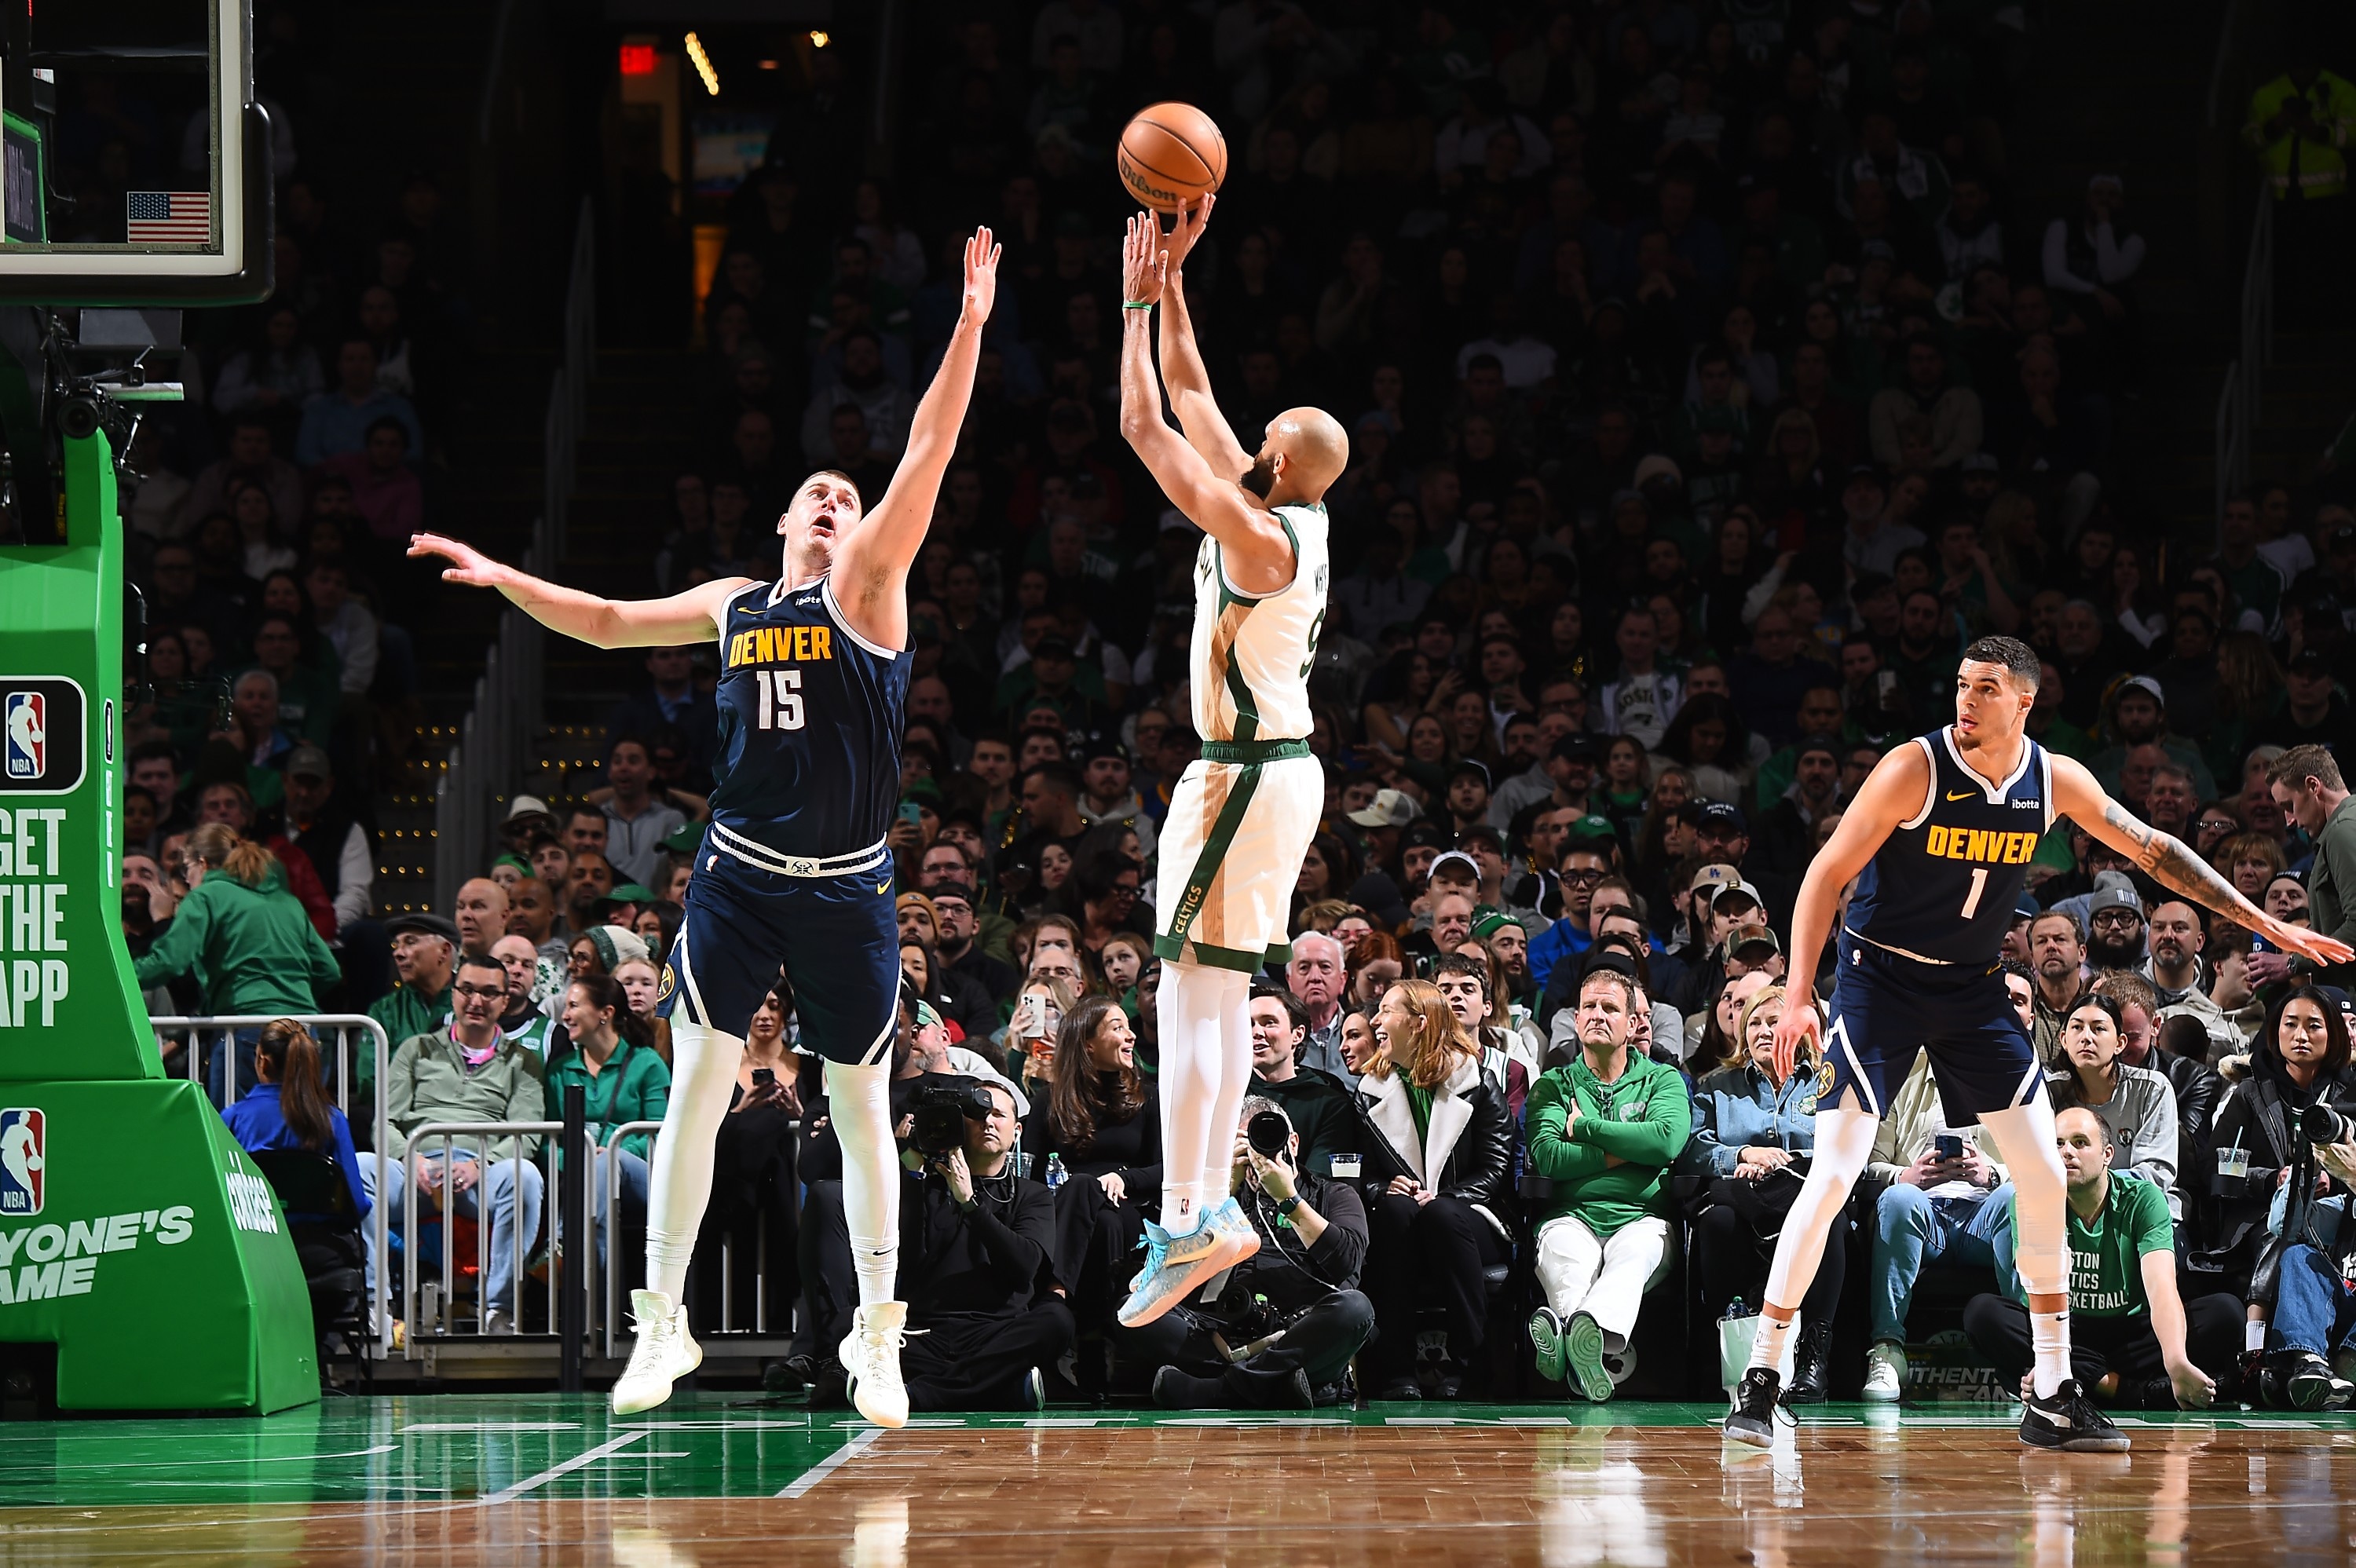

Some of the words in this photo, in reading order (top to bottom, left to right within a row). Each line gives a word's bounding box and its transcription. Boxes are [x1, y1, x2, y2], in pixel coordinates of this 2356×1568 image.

[1121, 155, 1176, 203] Wilson
[729, 626, 832, 668] DENVER
[756, 670, 805, 730] 15
[12, 758, 31, 773] NBA
[2011, 799, 2040, 810] ibotta
[1926, 825, 2038, 864] DENVER
[1175, 886, 1202, 934] CELTICS
[1961, 868, 1988, 919] 1
[3, 1191, 26, 1208] NBA
[2069, 1271, 2099, 1290] TICS
[1909, 1368, 1999, 1384] THENT
